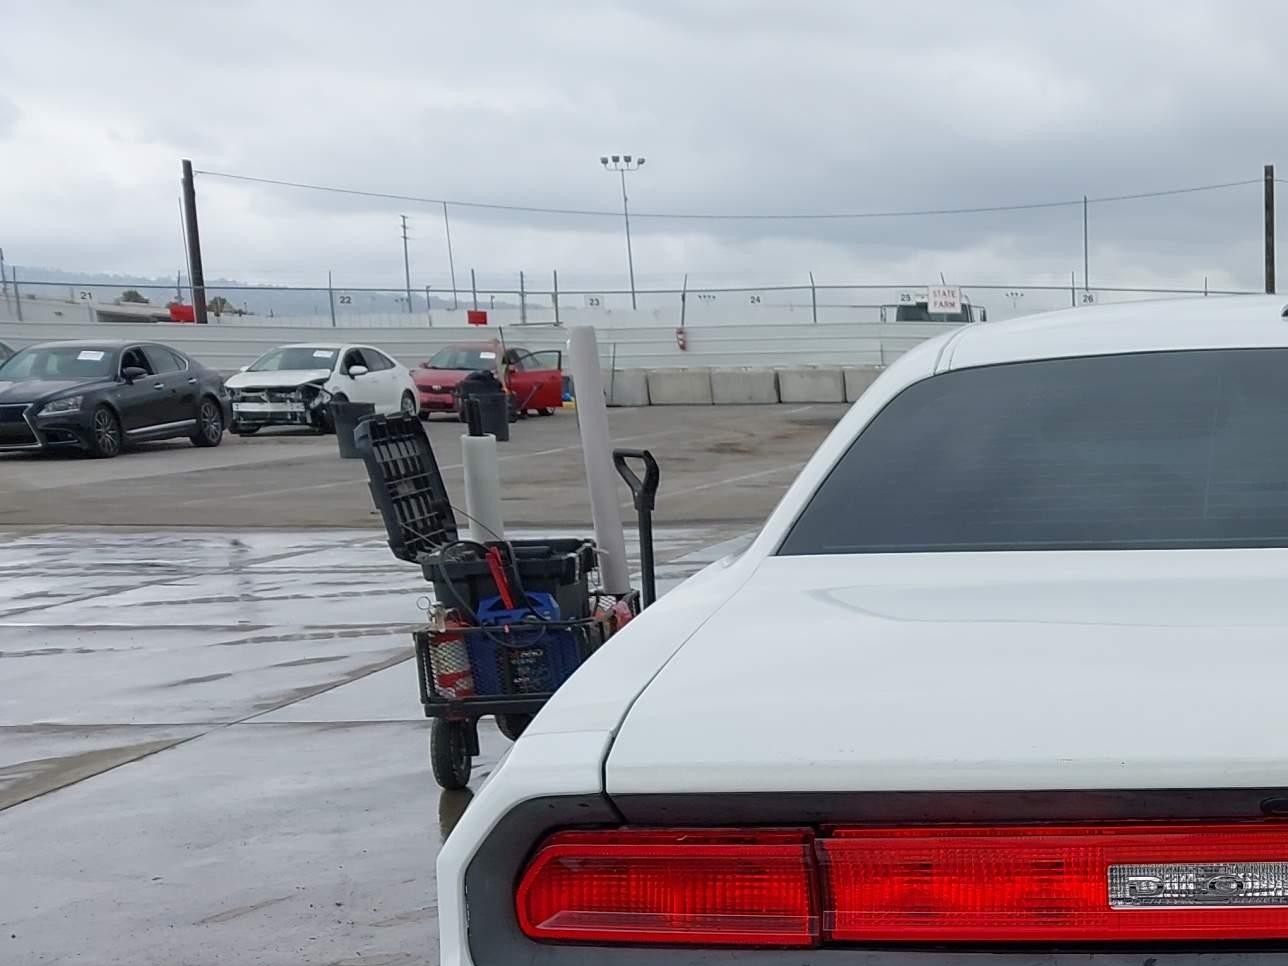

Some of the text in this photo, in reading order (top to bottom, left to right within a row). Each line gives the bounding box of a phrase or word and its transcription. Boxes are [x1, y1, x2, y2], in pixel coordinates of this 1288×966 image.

[79, 290, 93, 301] 21
[932, 288, 957, 298] STATE
[339, 295, 353, 305] 22
[749, 294, 762, 305] 24
[932, 300, 957, 309] FARM
